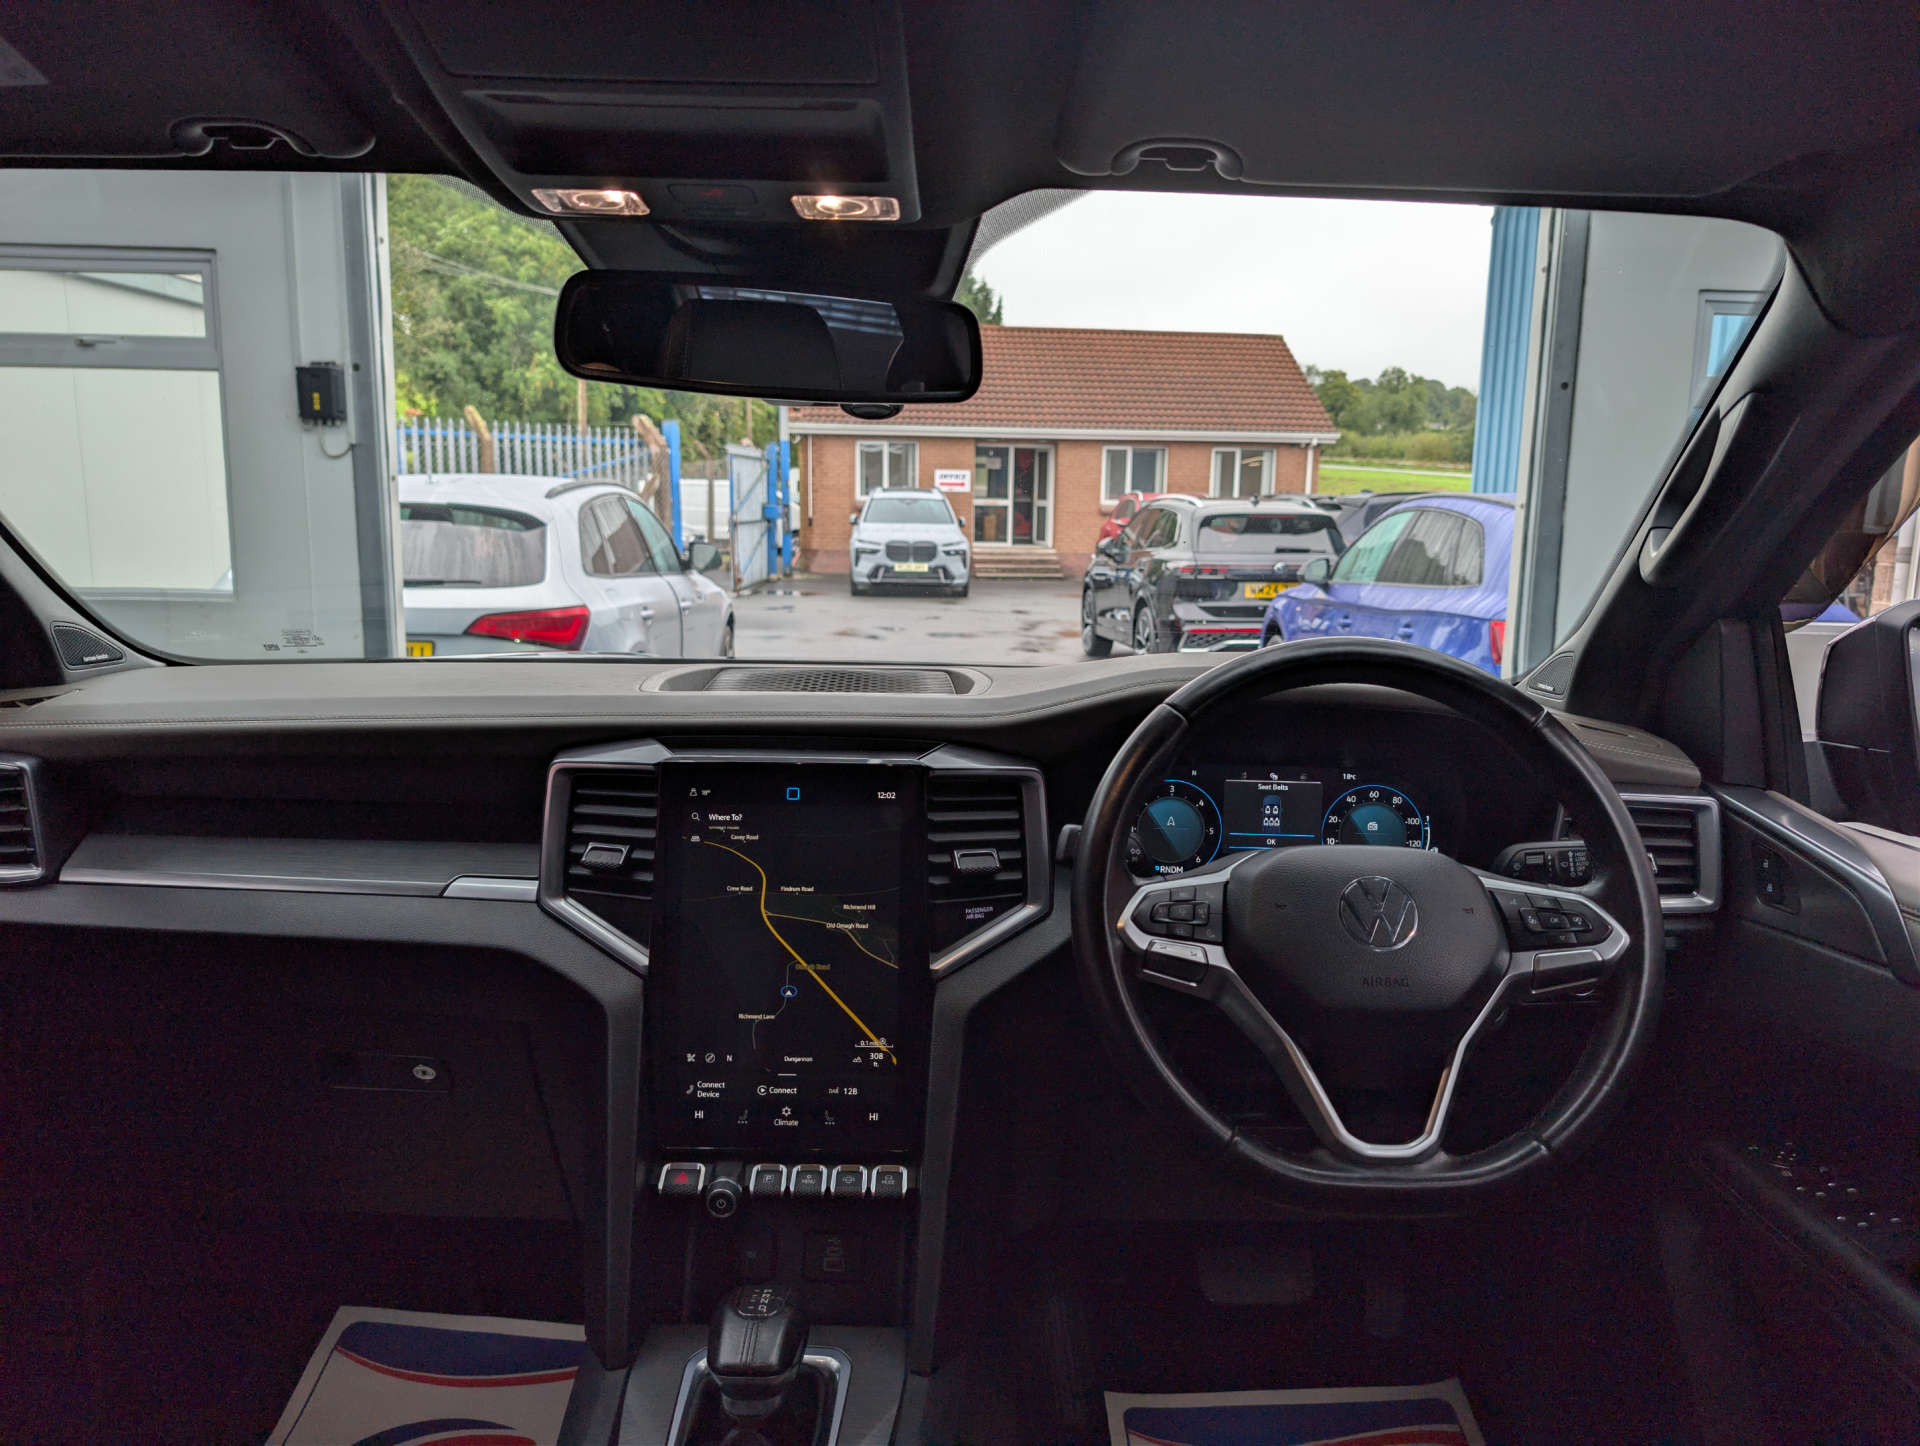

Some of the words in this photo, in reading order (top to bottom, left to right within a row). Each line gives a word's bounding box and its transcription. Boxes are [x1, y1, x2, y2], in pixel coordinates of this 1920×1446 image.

[1169, 785, 1175, 793] 3
[1257, 783, 1272, 791] Seat
[1272, 783, 1289, 791] Belts
[877, 791, 896, 799] 12:02
[1369, 790, 1380, 799] 60
[1346, 795, 1357, 803] 40
[1392, 796, 1403, 804] 80
[708, 813, 731, 821] Where
[731, 813, 743, 821] To?
[1160, 865, 1184, 874] RNDM
[1361, 976, 1409, 989] AIRBAG
[726, 1054, 733, 1062] N
[697, 1081, 726, 1089] Connect
[697, 1090, 720, 1099] Device
[768, 1086, 798, 1095] Connect
[773, 1118, 800, 1127] Climate
